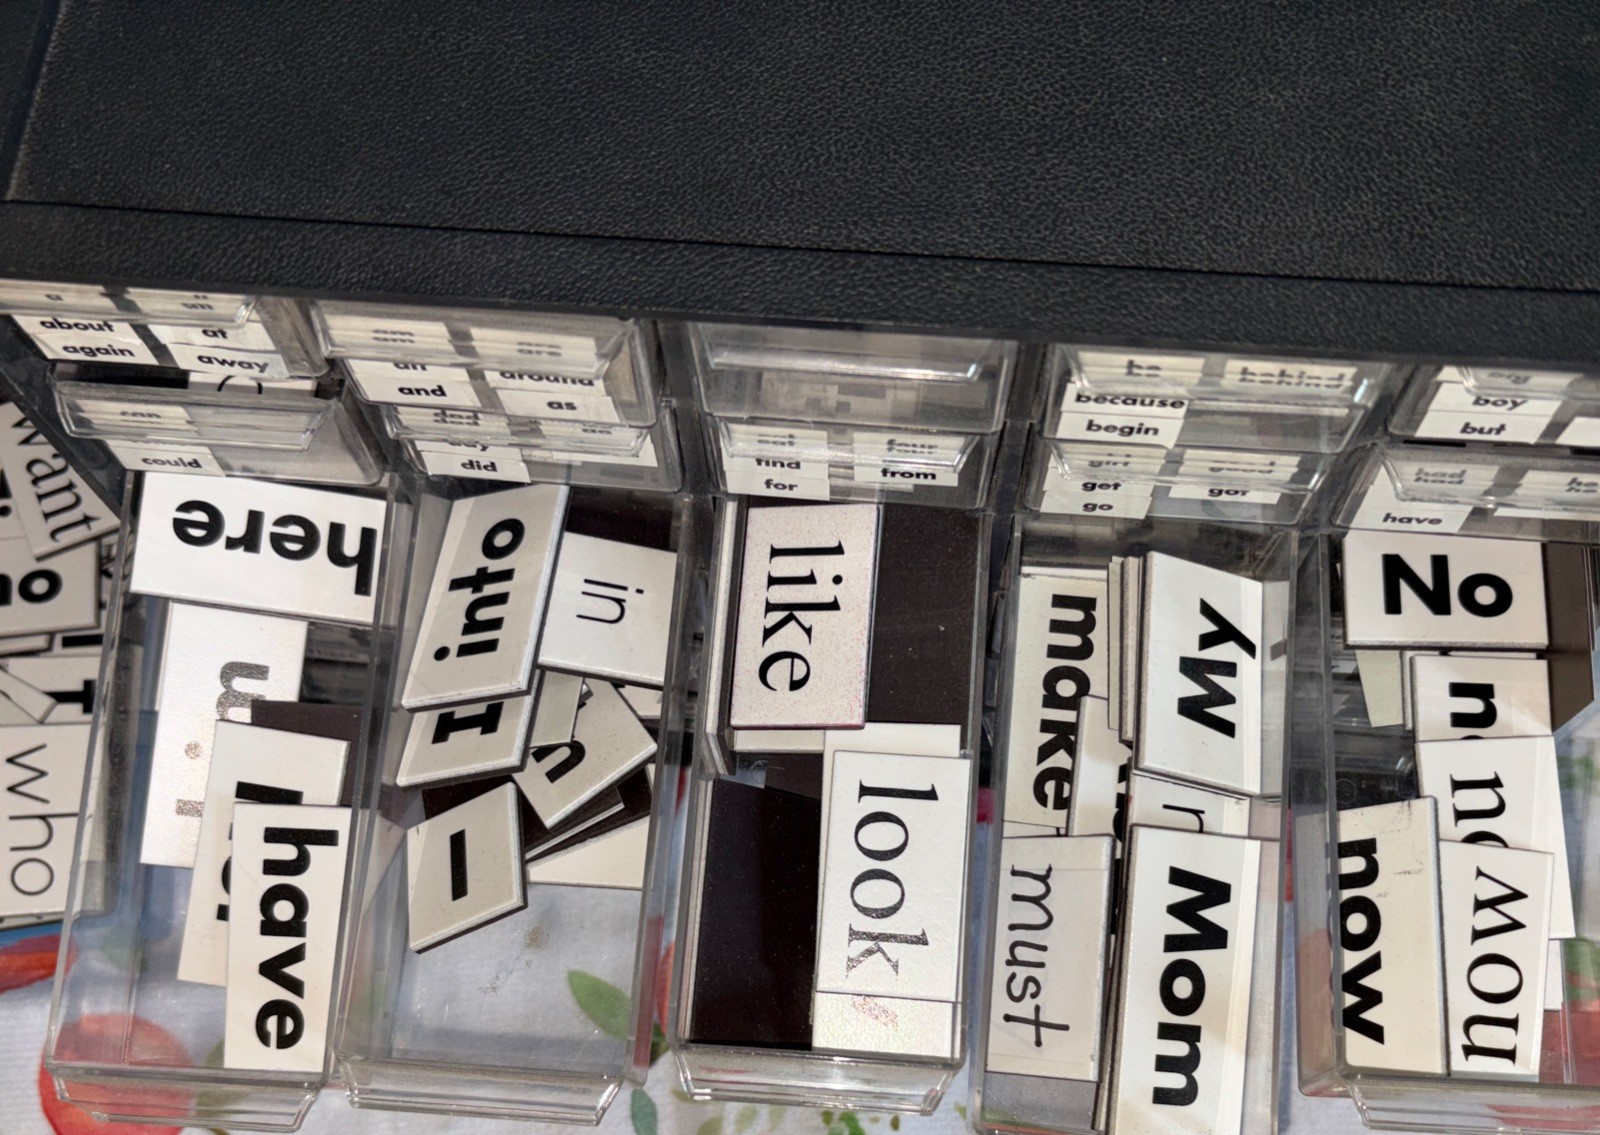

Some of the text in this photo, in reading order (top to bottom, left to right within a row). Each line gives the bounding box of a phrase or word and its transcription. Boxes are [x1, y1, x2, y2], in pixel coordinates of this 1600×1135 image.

[40, 317, 115, 333] about
[202, 327, 228, 340] at
[62, 343, 136, 359] again
[197, 353, 269, 373] away
[398, 385, 448, 398] and
[546, 398, 577, 411] as
[1074, 393, 1186, 411] because
[1471, 396, 1528, 411] boy
[1085, 419, 1159, 438] begin
[1459, 421, 1507, 436] but
[141, 457, 203, 469] could
[461, 459, 498, 473] did
[881, 467, 937, 480] from
[764, 478, 799, 491] for
[1082, 502, 1113, 513] go
[1382, 512, 1443, 526] have
[172, 499, 378, 597] here
[433, 517, 526, 661] into
[1381, 553, 1514, 618] No
[576, 578, 645, 625] in
[758, 539, 845, 692] like
[1177, 597, 1257, 739] My
[1032, 593, 1098, 810] make
[5, 743, 80, 896] who
[845, 778, 939, 979] look
[255, 826, 340, 1050] have
[1337, 836, 1385, 1046] now
[1002, 863, 1071, 1048] must
[1460, 865, 1529, 1067] now
[1151, 865, 1232, 1107] Mom
